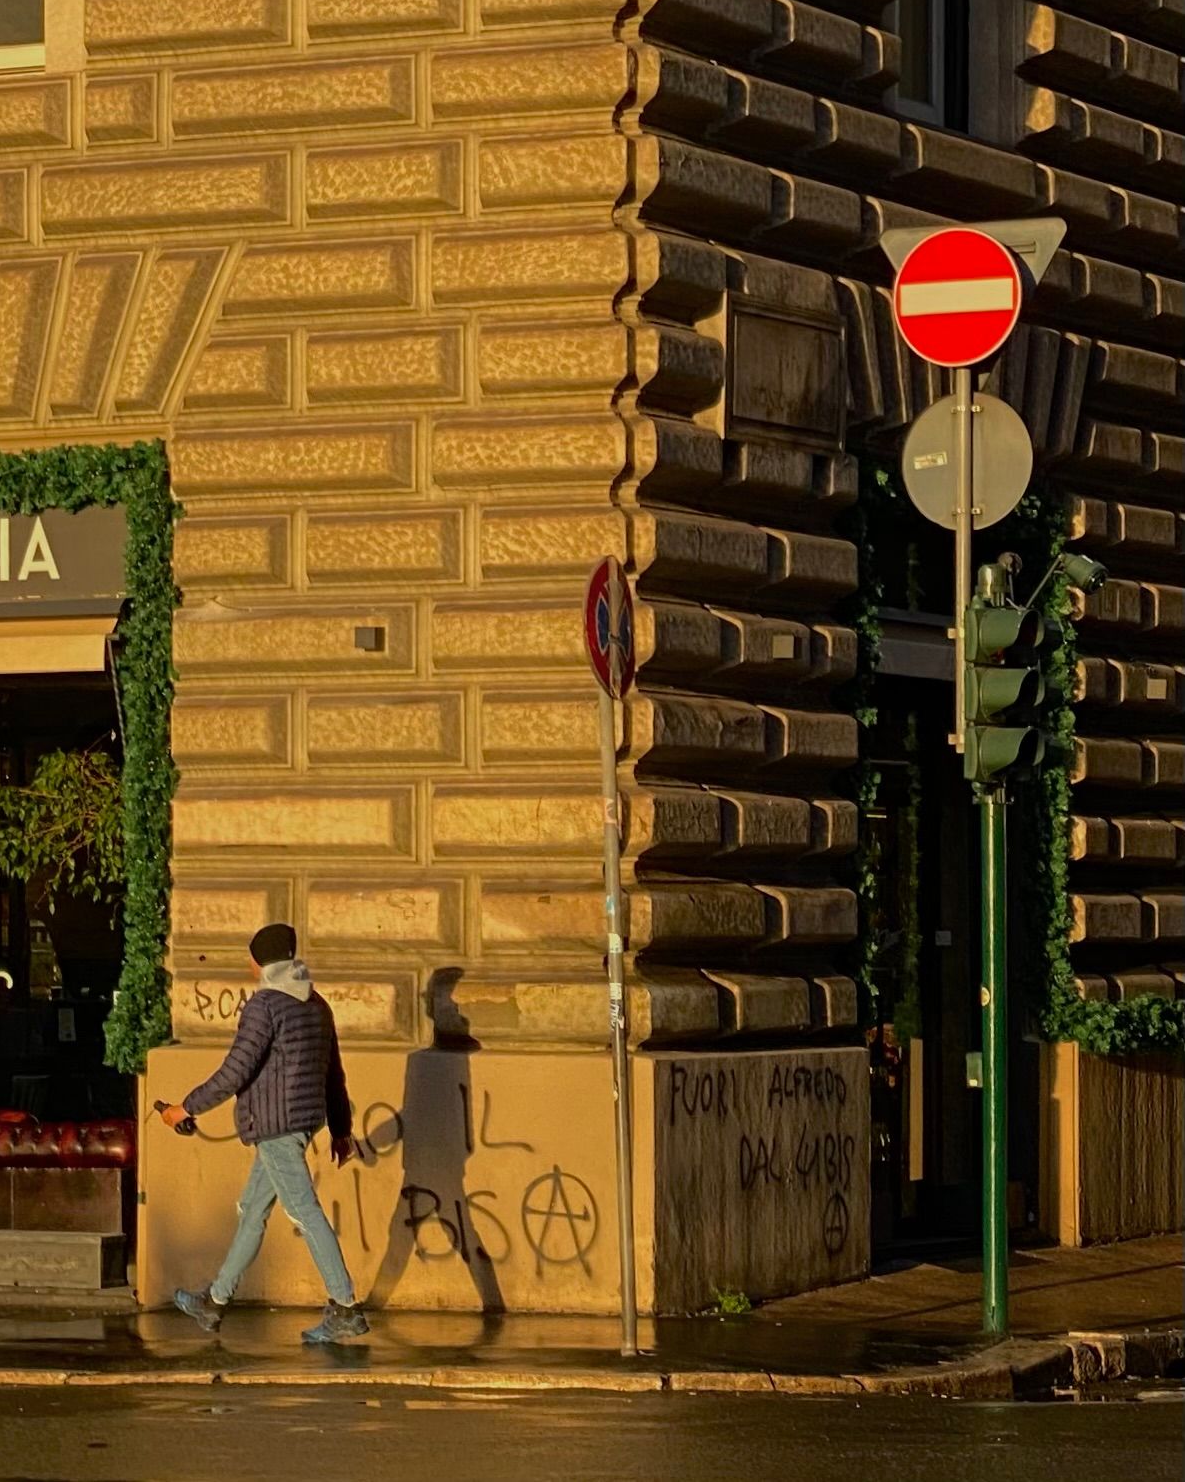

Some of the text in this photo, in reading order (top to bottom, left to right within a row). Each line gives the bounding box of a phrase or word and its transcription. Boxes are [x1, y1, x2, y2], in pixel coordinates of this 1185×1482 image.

[670, 1062, 737, 1126] FUORI
[740, 1134, 783, 1191] DAL
[401, 1185, 511, 1264] BIS
